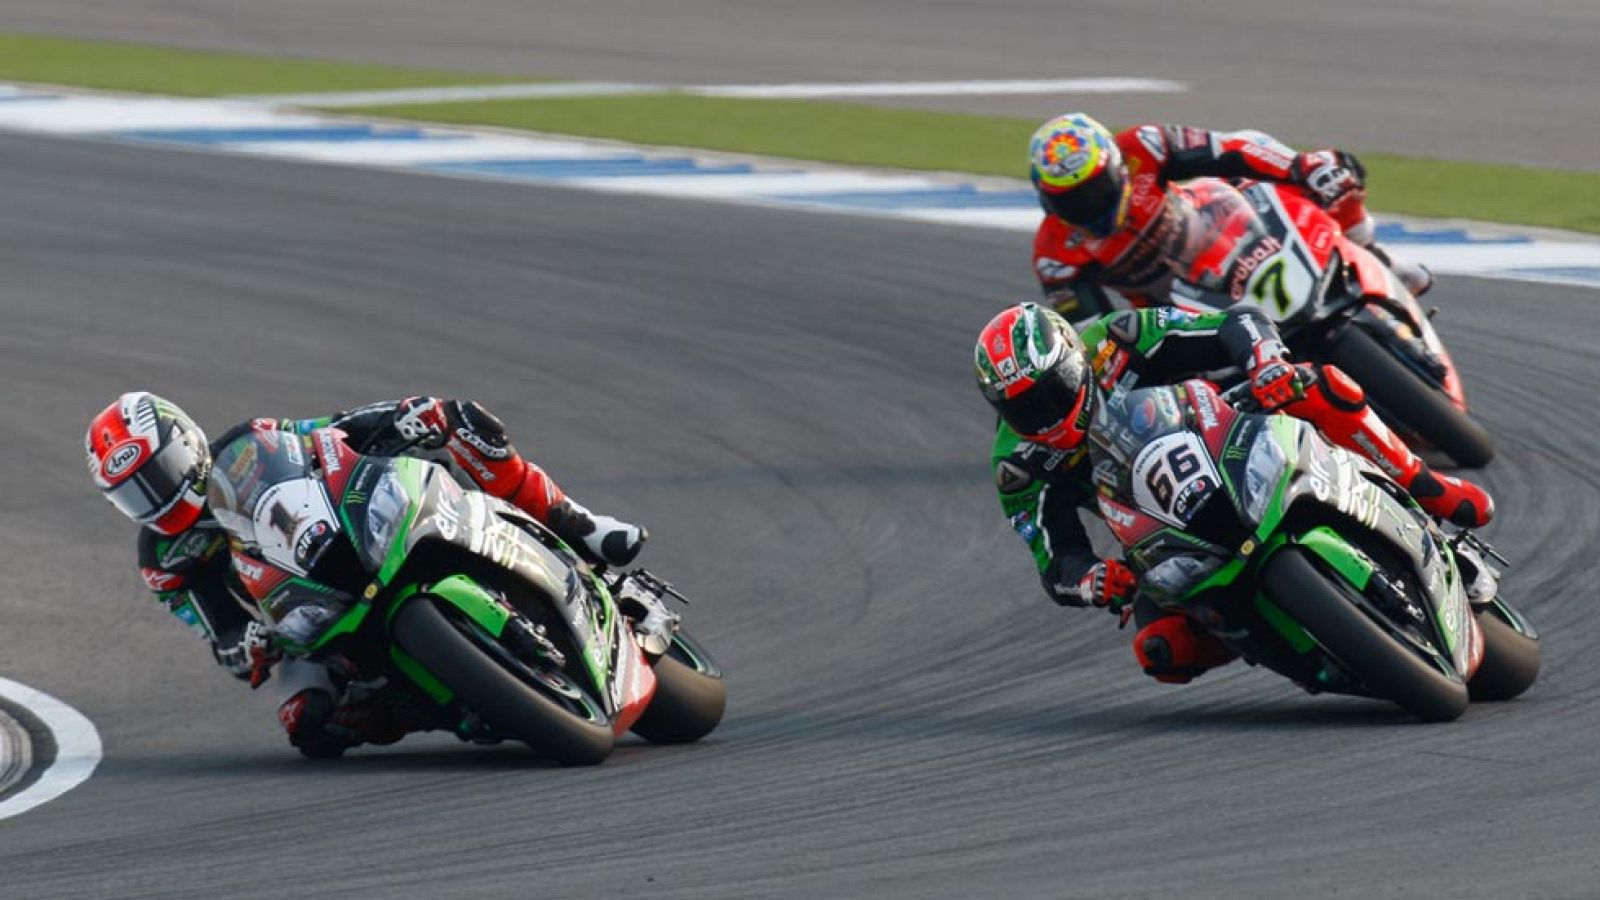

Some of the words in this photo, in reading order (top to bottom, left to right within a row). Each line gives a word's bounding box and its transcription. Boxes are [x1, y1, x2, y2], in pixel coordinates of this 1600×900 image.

[1253, 257, 1293, 316] 7
[1145, 443, 1202, 514] 66
[1309, 445, 1332, 502] elf
[269, 500, 312, 550] 1
[435, 490, 461, 541] elf
